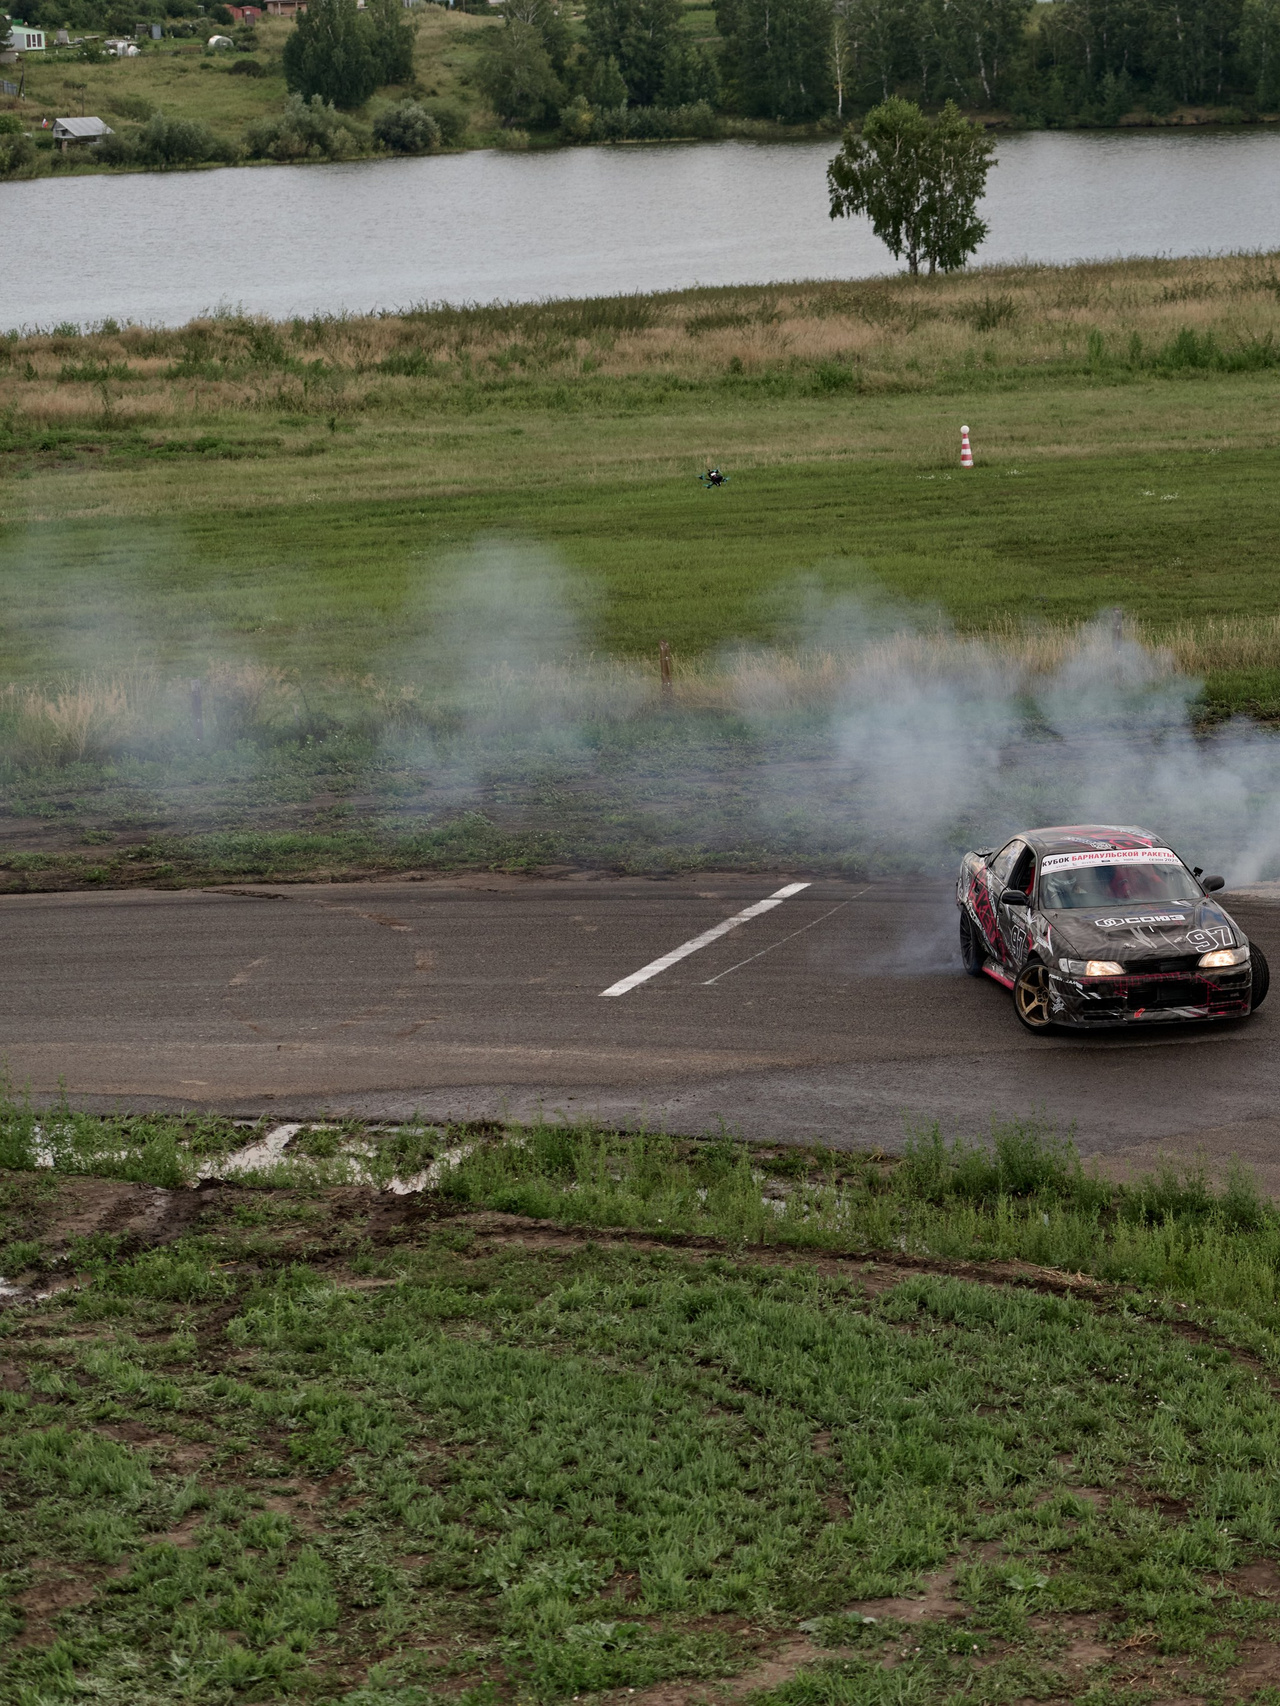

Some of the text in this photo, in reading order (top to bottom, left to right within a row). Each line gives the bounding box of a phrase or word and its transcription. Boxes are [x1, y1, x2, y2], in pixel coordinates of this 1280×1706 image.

[1042, 857, 1070, 867] КУБОК
[1071, 851, 1139, 862] БАРНАУЛЬСКОЙ
[1124, 914, 1186, 924] СОЮЗ
[1011, 925, 1027, 961] 97
[1185, 925, 1234, 953] 97
